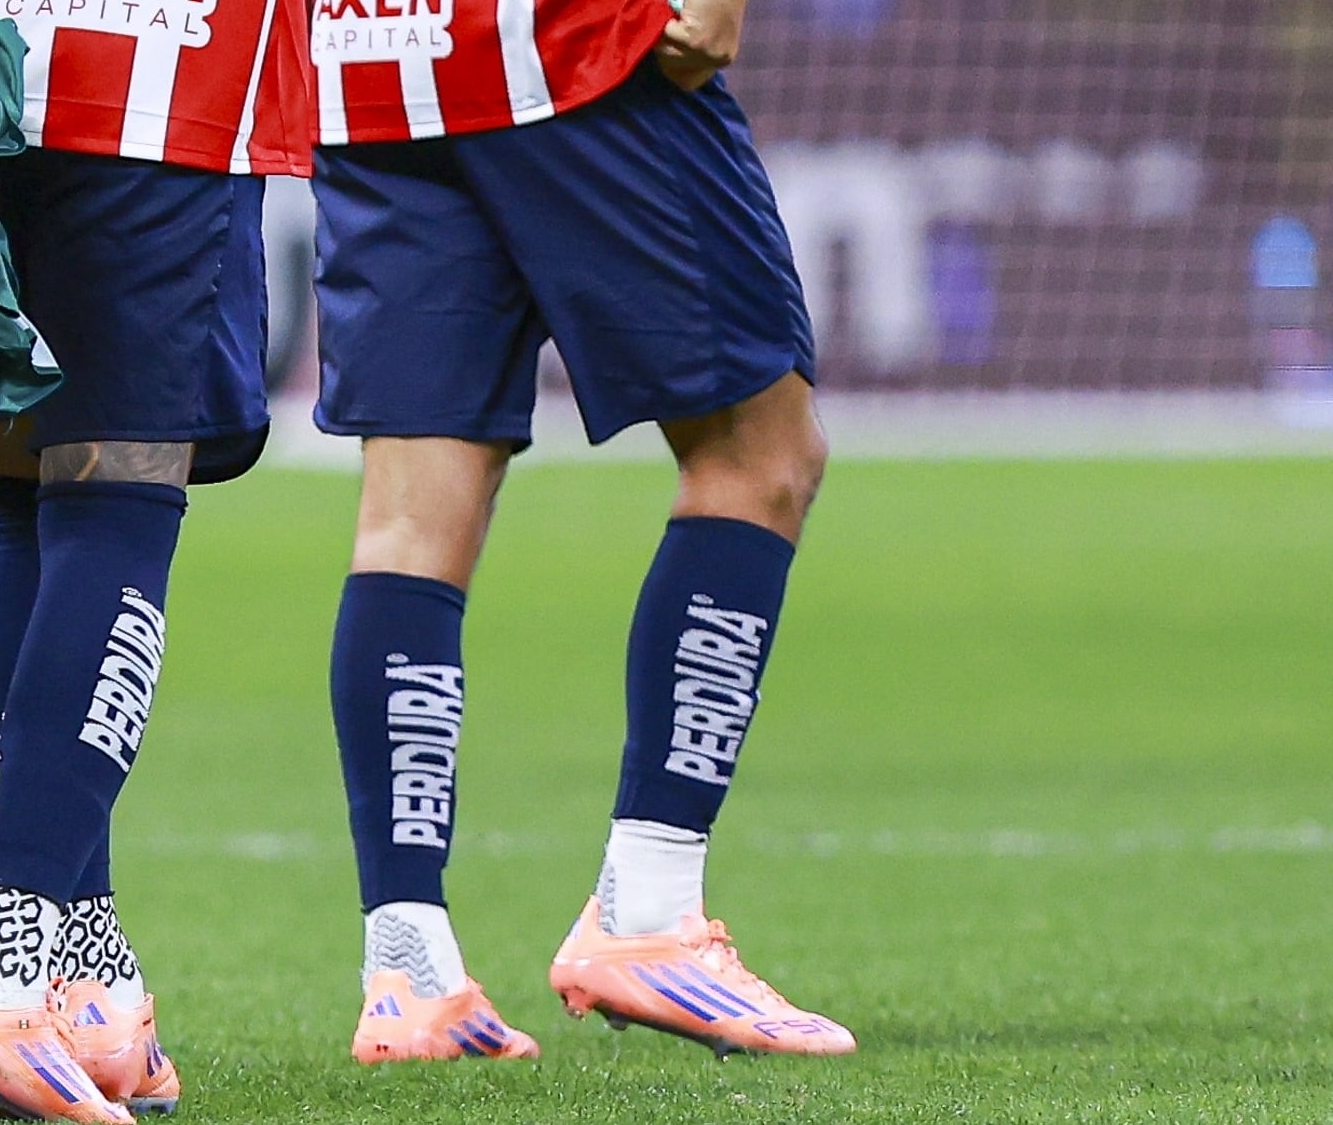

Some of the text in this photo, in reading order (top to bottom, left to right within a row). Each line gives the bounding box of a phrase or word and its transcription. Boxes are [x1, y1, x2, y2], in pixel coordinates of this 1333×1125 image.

[78, 593, 166, 773] PERDURA
[385, 663, 463, 849] PERDURA
[665, 605, 769, 786] PERDURA
